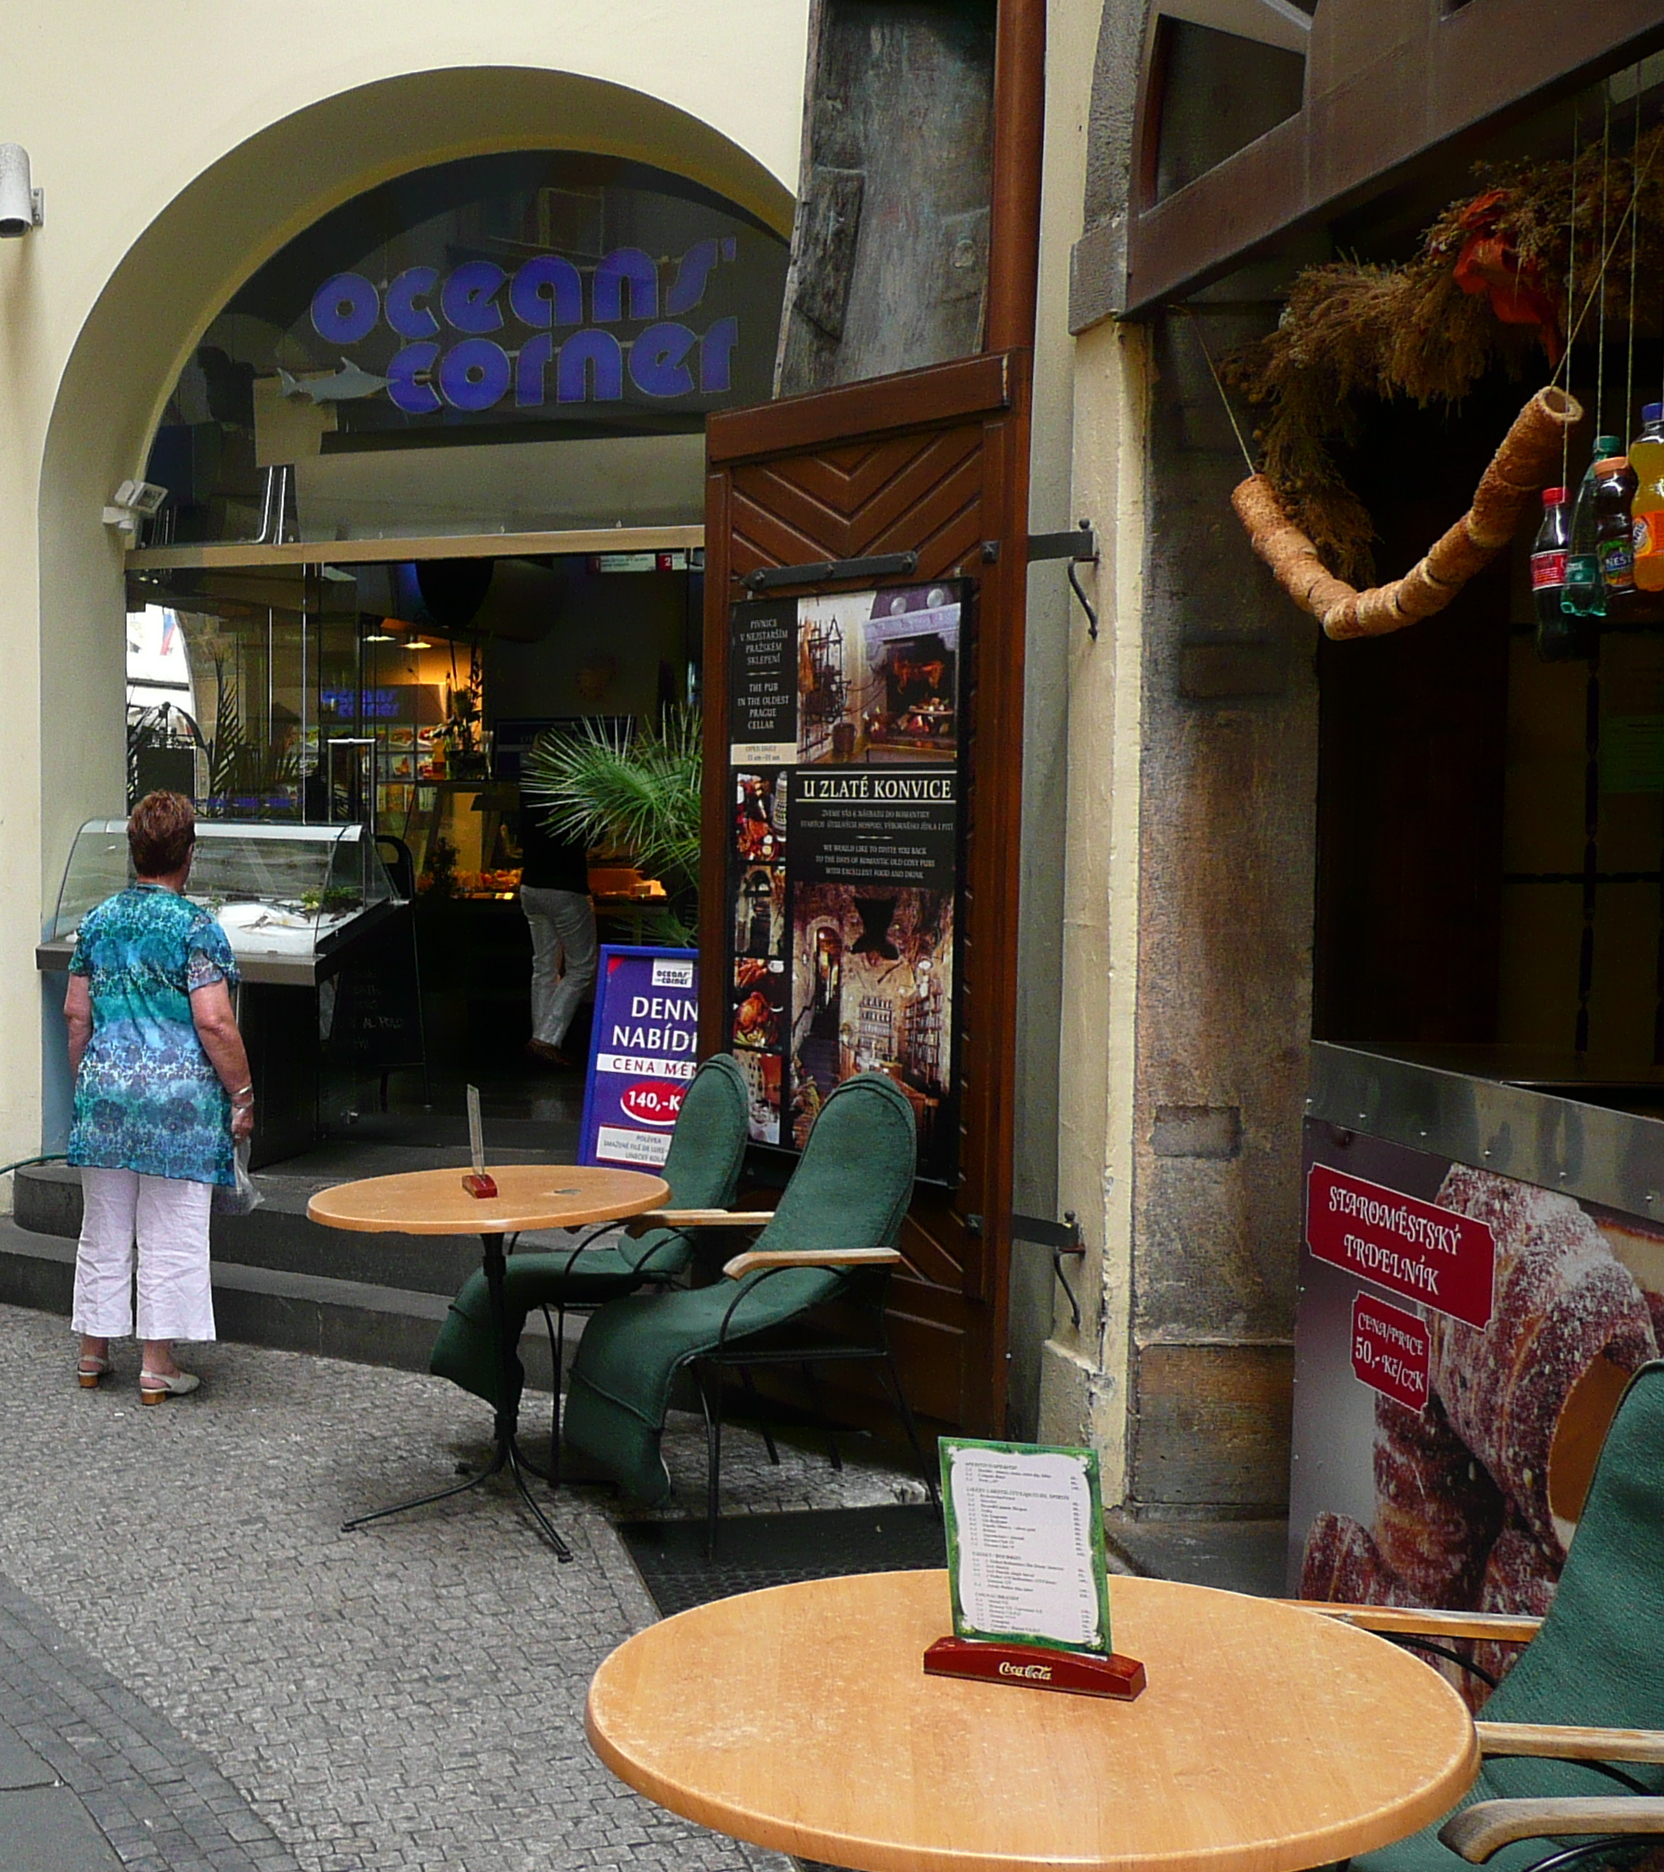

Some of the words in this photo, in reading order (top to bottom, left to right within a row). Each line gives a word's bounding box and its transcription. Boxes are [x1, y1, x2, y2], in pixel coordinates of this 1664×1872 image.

[386, 316, 737, 414] corner
[749, 683, 763, 693] THE
[764, 682, 778, 692] PUB
[738, 697, 746, 707] IN
[747, 697, 761, 706] THE
[762, 695, 789, 706] OLDEST
[749, 708, 777, 718] PRAGUE
[747, 720, 774, 730] CELLAR
[804, 780, 815, 797] U
[820, 775, 869, 798] ZLATÉ
[874, 780, 951, 798] KONVICE
[613, 1058, 655, 1073] CENA
[1329, 1186, 1461, 1256] STAROMĚSTSKÝ
[1344, 1234, 1440, 1296] TRDELNÍK
[1358, 1312, 1424, 1356] CENA/PRICE
